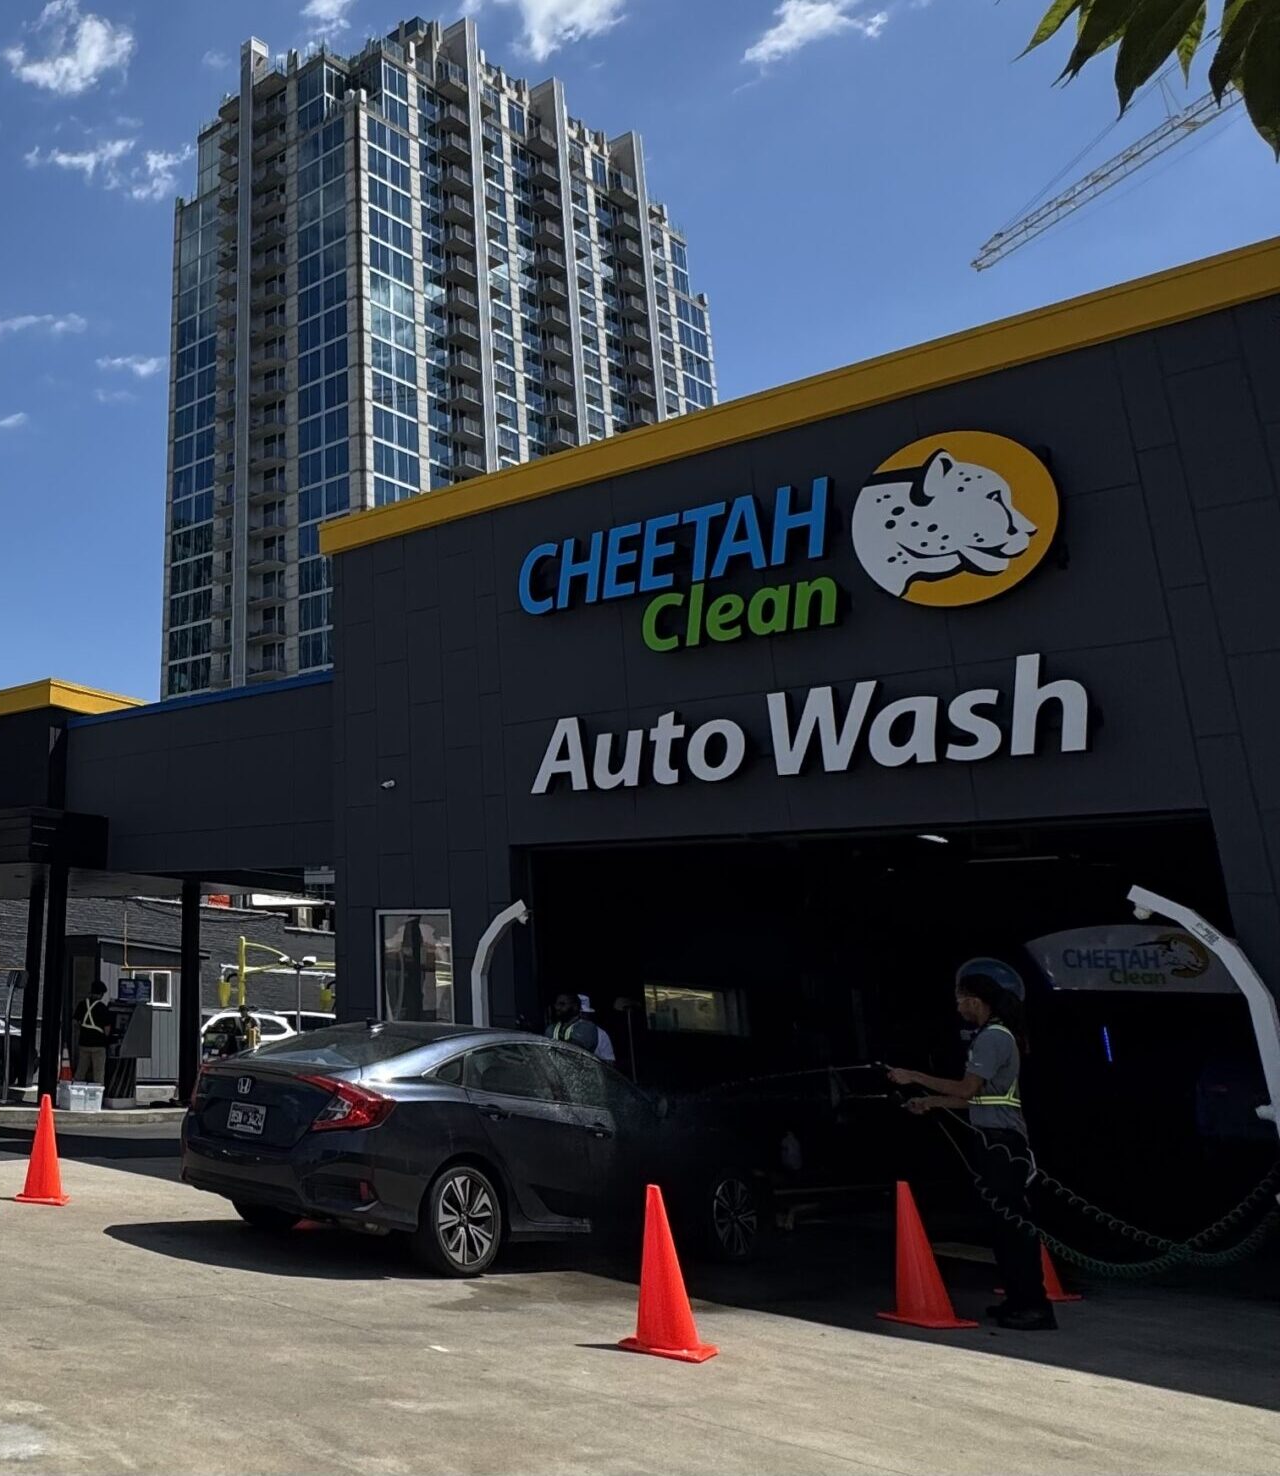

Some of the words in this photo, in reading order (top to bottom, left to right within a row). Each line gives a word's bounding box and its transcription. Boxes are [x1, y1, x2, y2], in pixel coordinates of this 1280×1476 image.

[518, 476, 829, 615] CHEETAH
[642, 576, 838, 652] Clean
[530, 711, 746, 795] Auto
[766, 653, 1089, 776] Wash
[1062, 948, 1161, 969] CHEETAH
[1109, 967, 1166, 985] Clean
